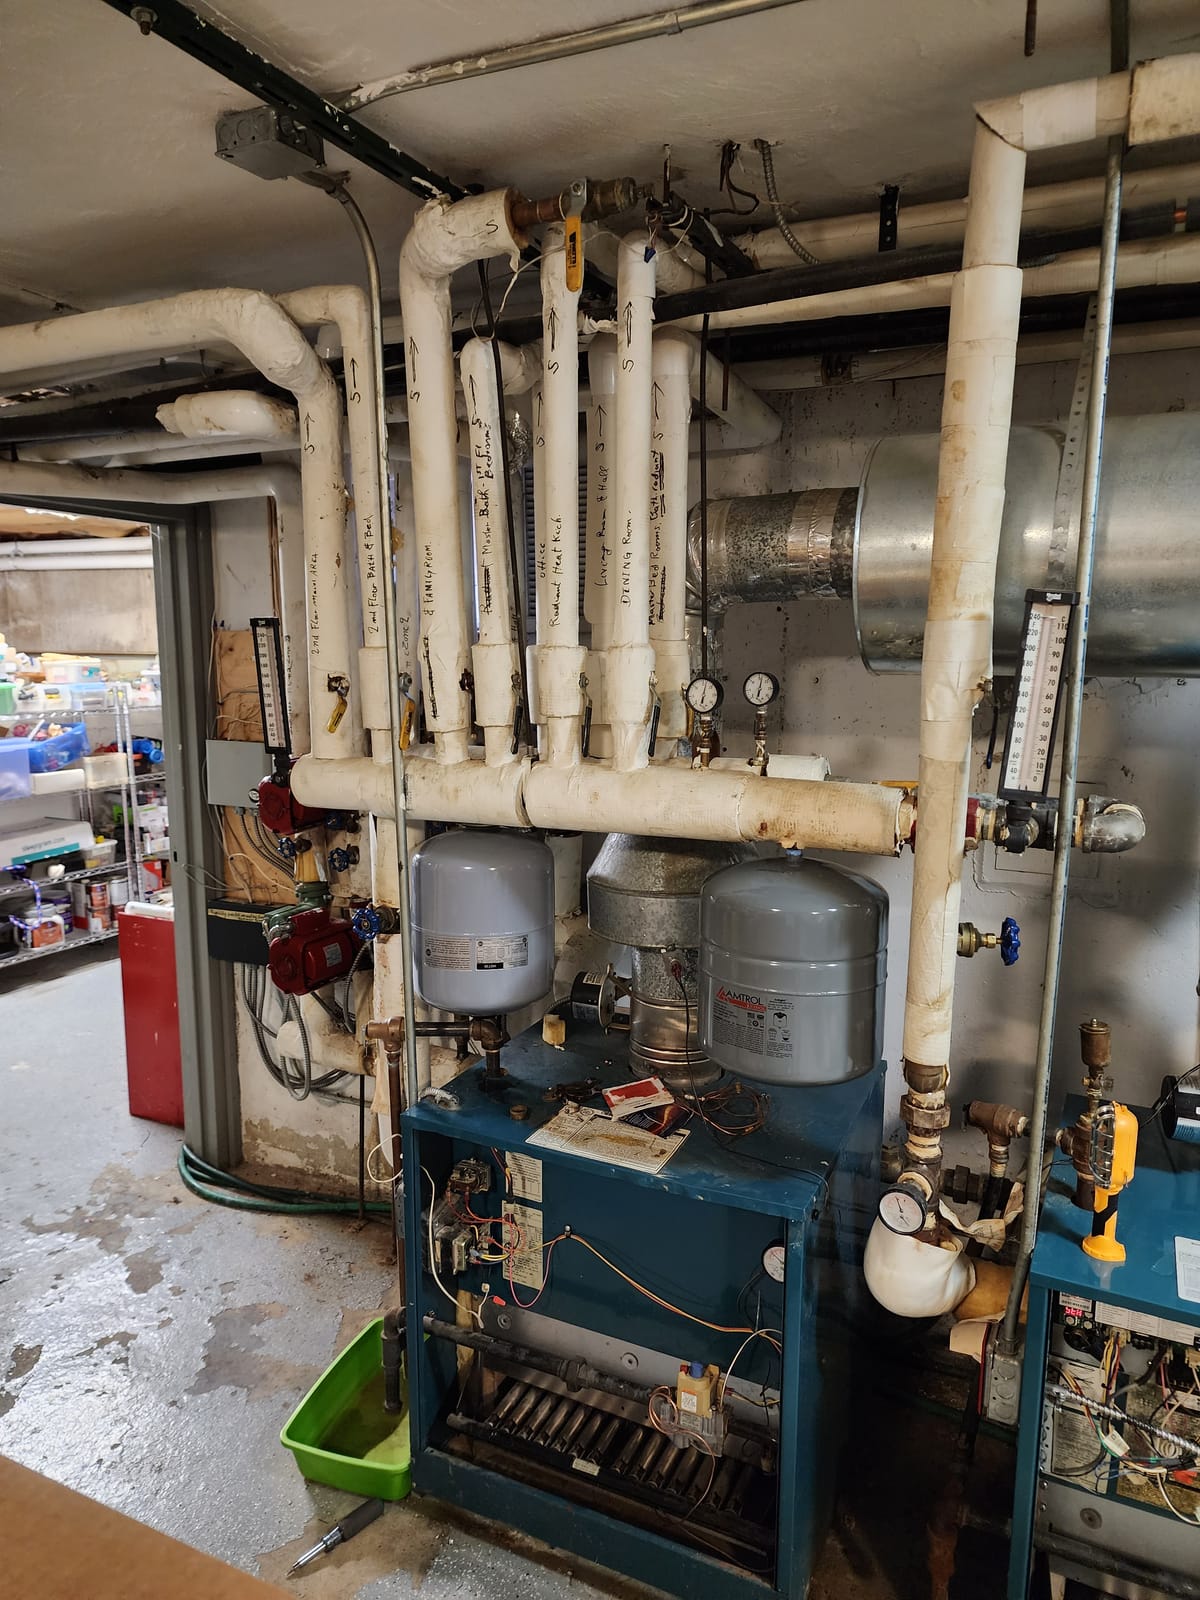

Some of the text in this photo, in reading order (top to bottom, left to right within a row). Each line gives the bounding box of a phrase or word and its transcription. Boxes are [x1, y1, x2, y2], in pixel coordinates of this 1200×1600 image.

[547, 360, 559, 375] S
[622, 359, 634, 373] S
[725, 989, 764, 1006] AMTROL
